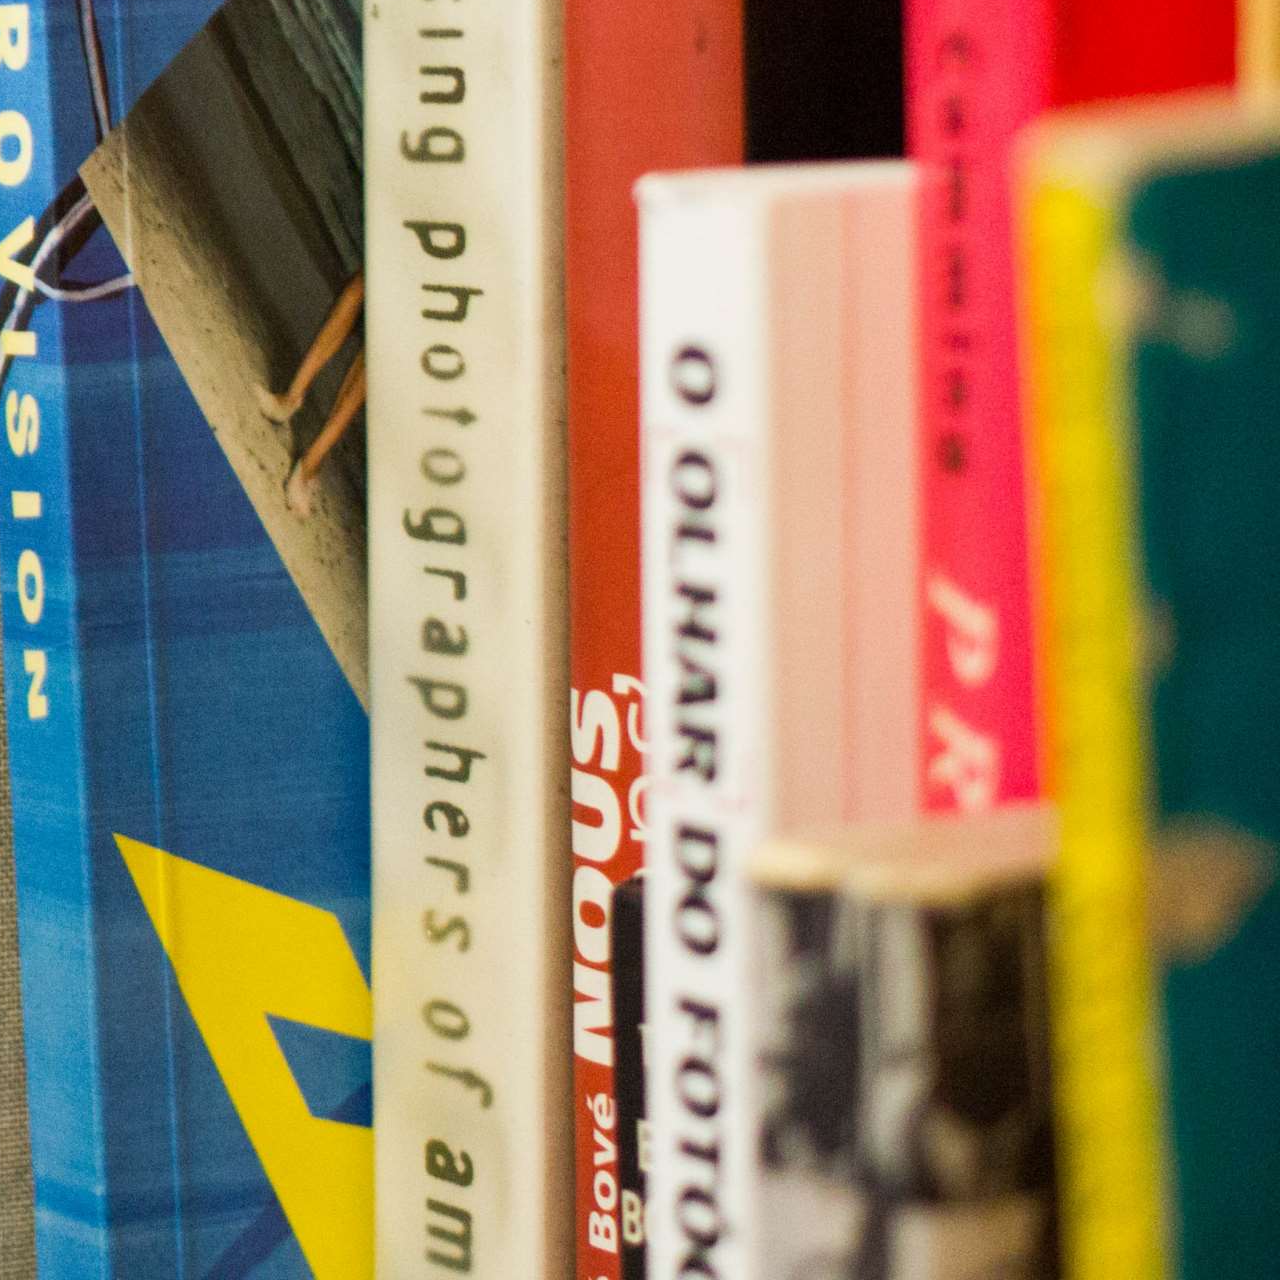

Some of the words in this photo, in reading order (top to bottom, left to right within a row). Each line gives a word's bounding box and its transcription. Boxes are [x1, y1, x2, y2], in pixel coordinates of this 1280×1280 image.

[401, 218, 488, 954] photographers
[672, 449, 718, 784] OLHAR
[674, 824, 720, 957] DO
[422, 998, 494, 1110] of
[587, 1091, 616, 1253] Bové
